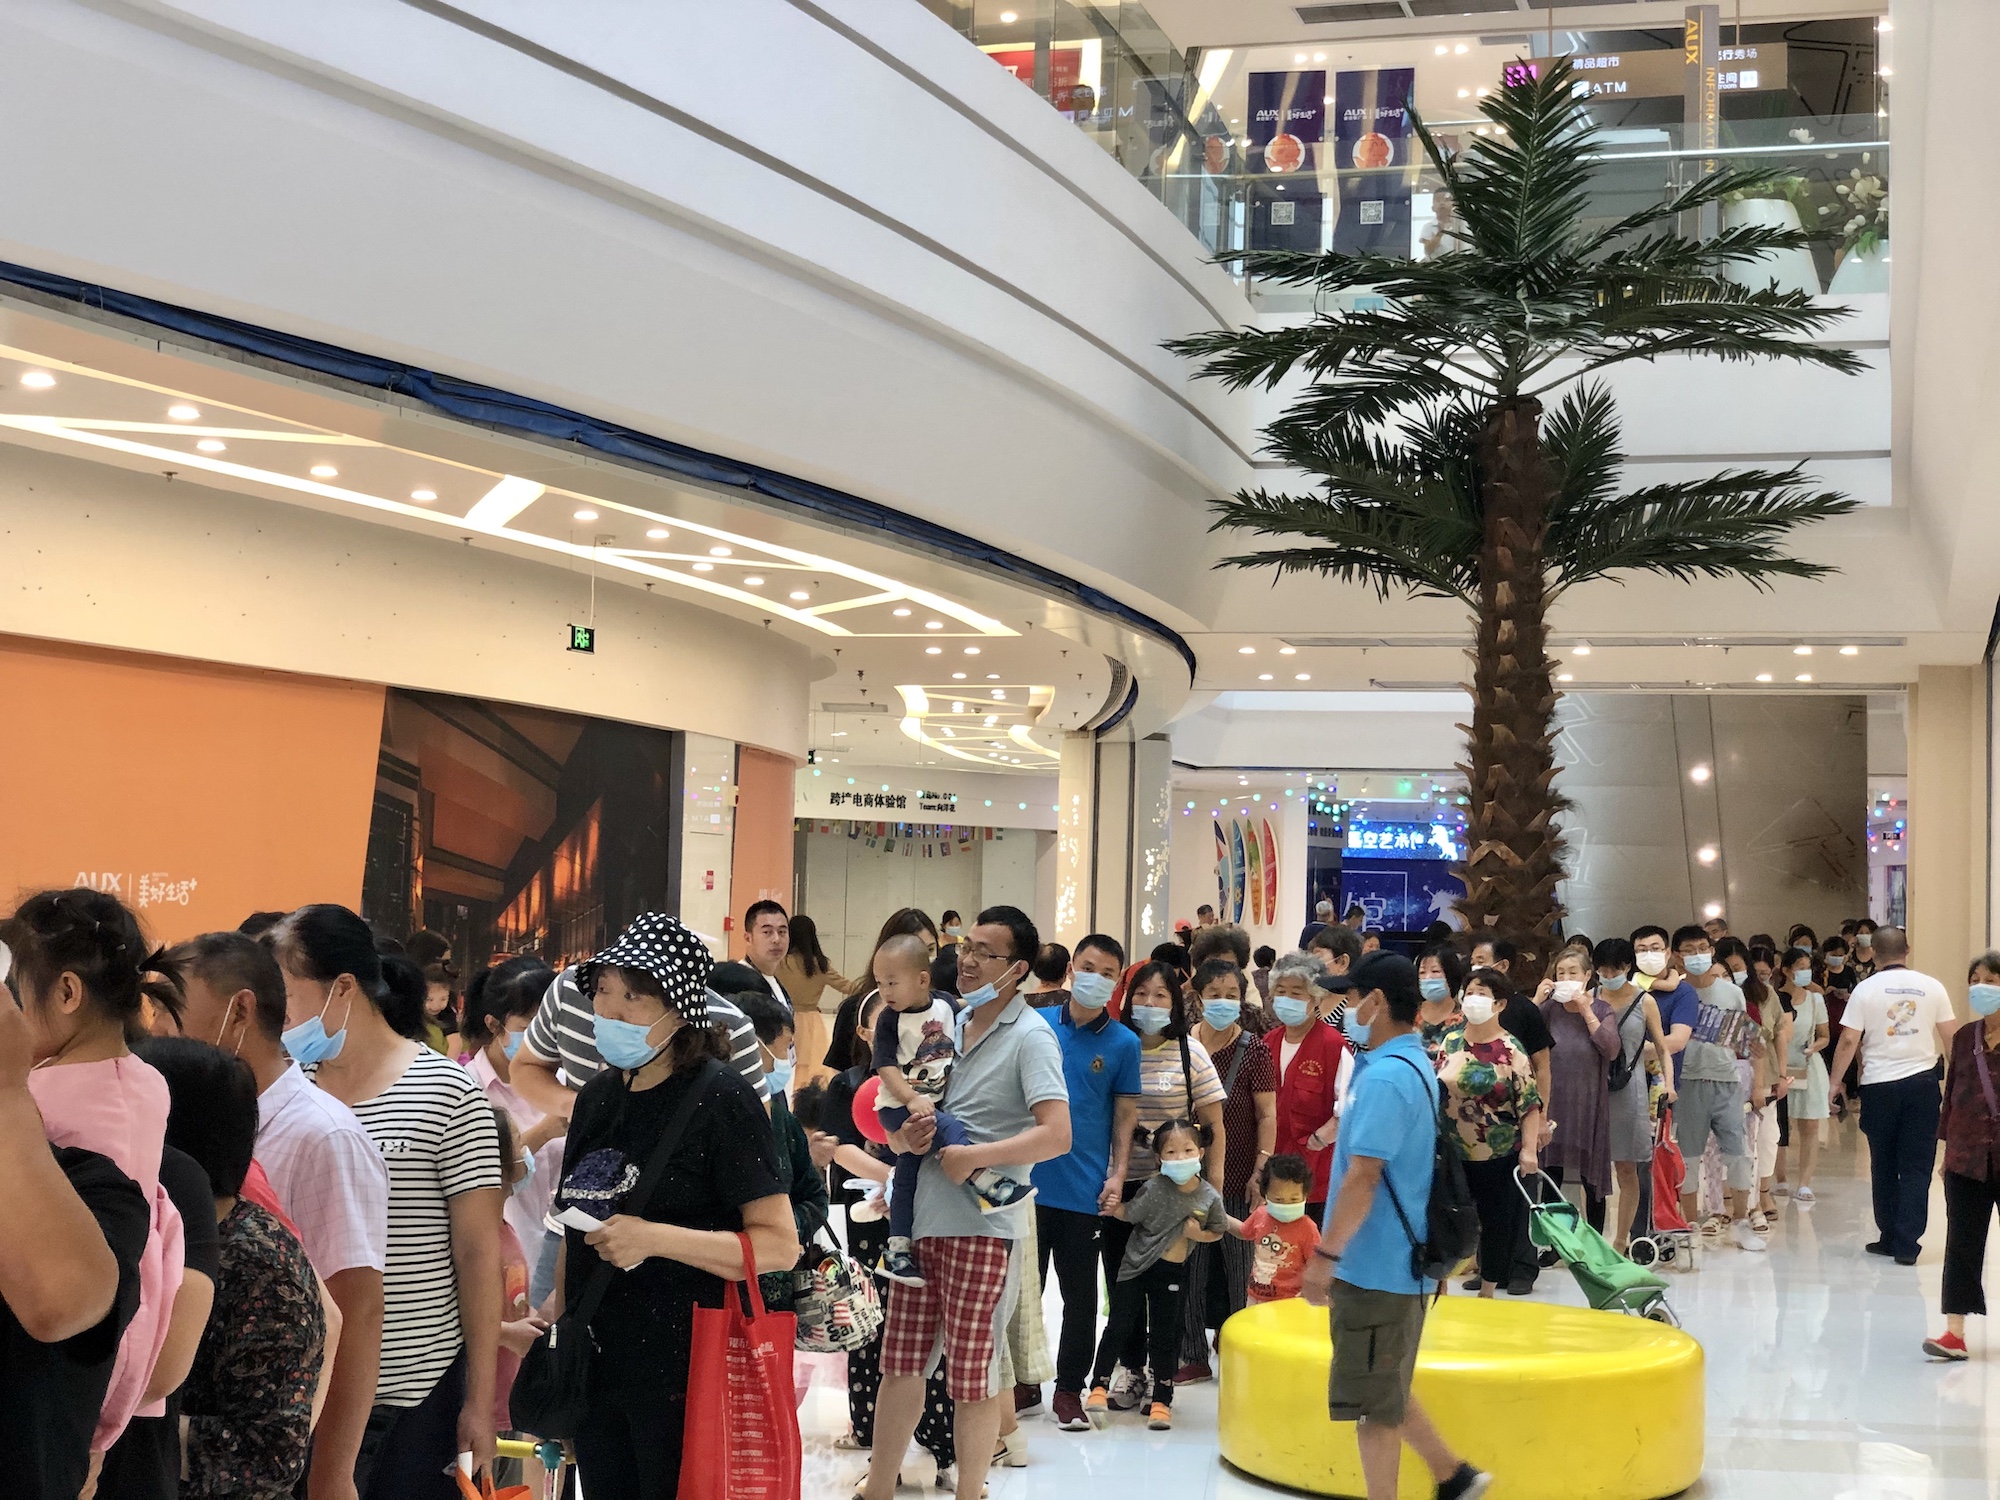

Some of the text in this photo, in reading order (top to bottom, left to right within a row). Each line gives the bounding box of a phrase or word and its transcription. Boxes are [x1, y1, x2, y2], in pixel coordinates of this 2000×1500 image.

[1685, 19, 1699, 65] AUX
[1593, 81, 1627, 95] ATM
[1705, 67, 1715, 173] INFORMATIN
